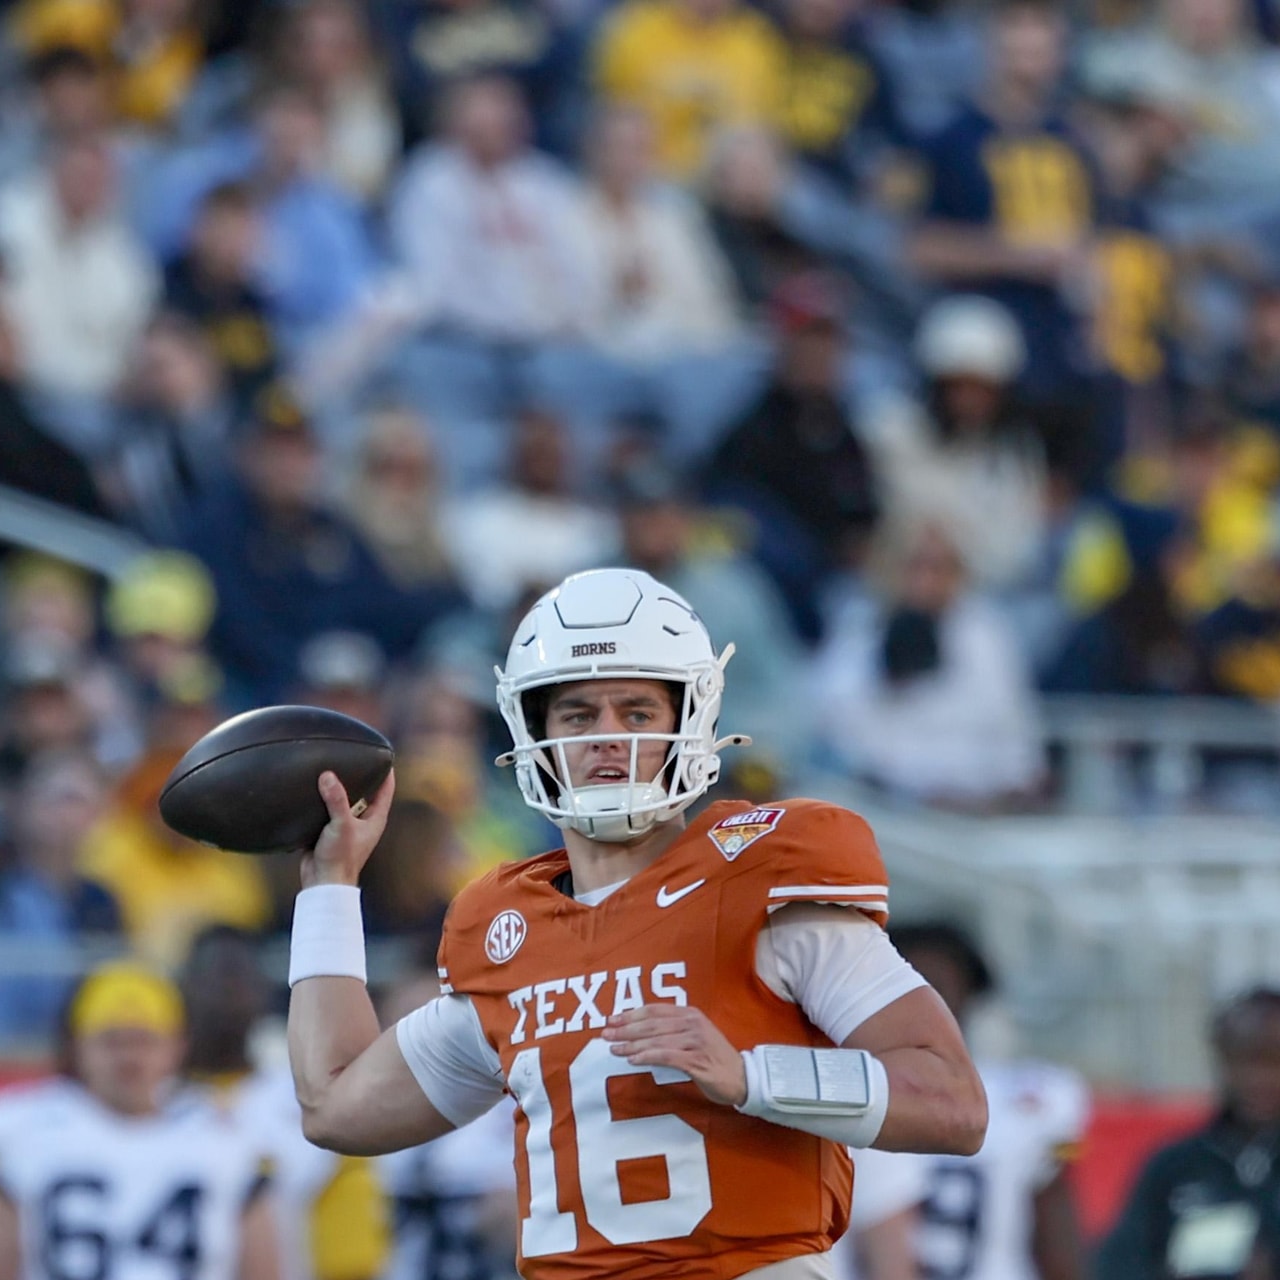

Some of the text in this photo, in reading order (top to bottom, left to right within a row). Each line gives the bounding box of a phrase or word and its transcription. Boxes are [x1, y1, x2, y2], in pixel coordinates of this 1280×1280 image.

[570, 642, 617, 658] HORNS
[487, 911, 524, 962] SEC
[507, 961, 688, 1045] TEXAS
[507, 1037, 713, 1258] 16
